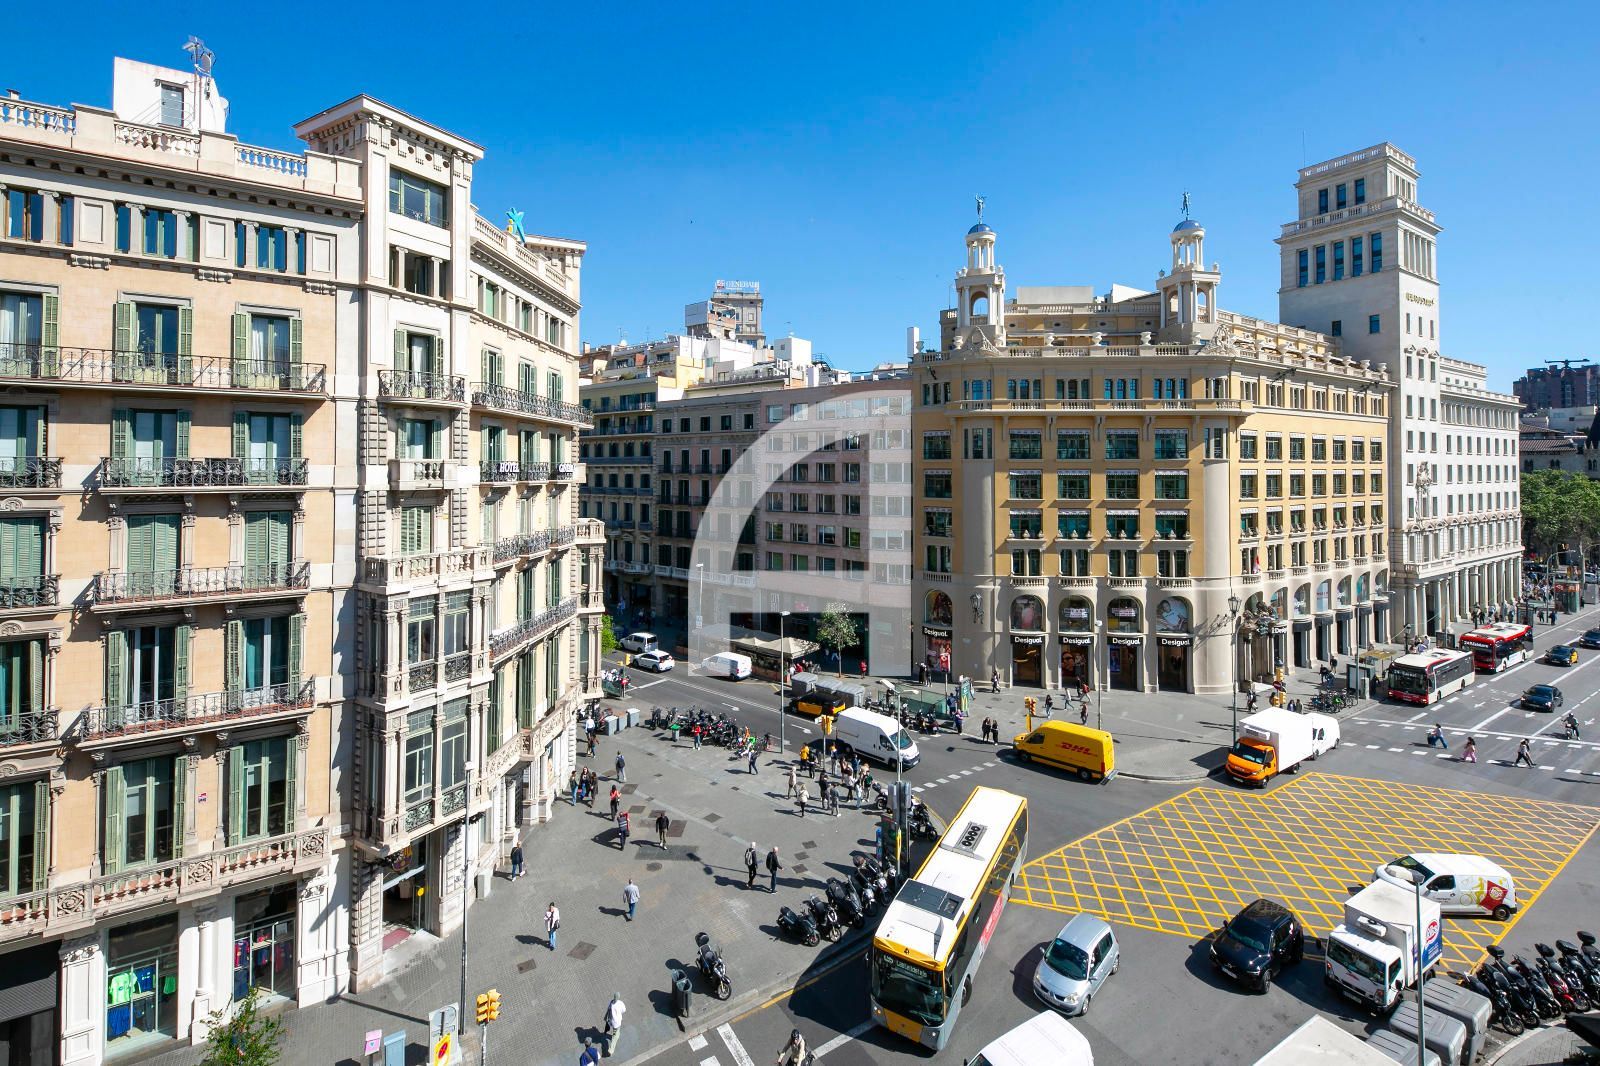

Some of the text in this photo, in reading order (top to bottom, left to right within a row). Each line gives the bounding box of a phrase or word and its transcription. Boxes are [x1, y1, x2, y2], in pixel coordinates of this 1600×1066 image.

[924, 627, 948, 637] Desigual
[1014, 636, 1042, 645] Desigual
[1063, 637, 1091, 645] Desigual
[1112, 638, 1140, 646] Desigual
[1161, 638, 1190, 647] Desigual
[1061, 742, 1090, 754] DHL
